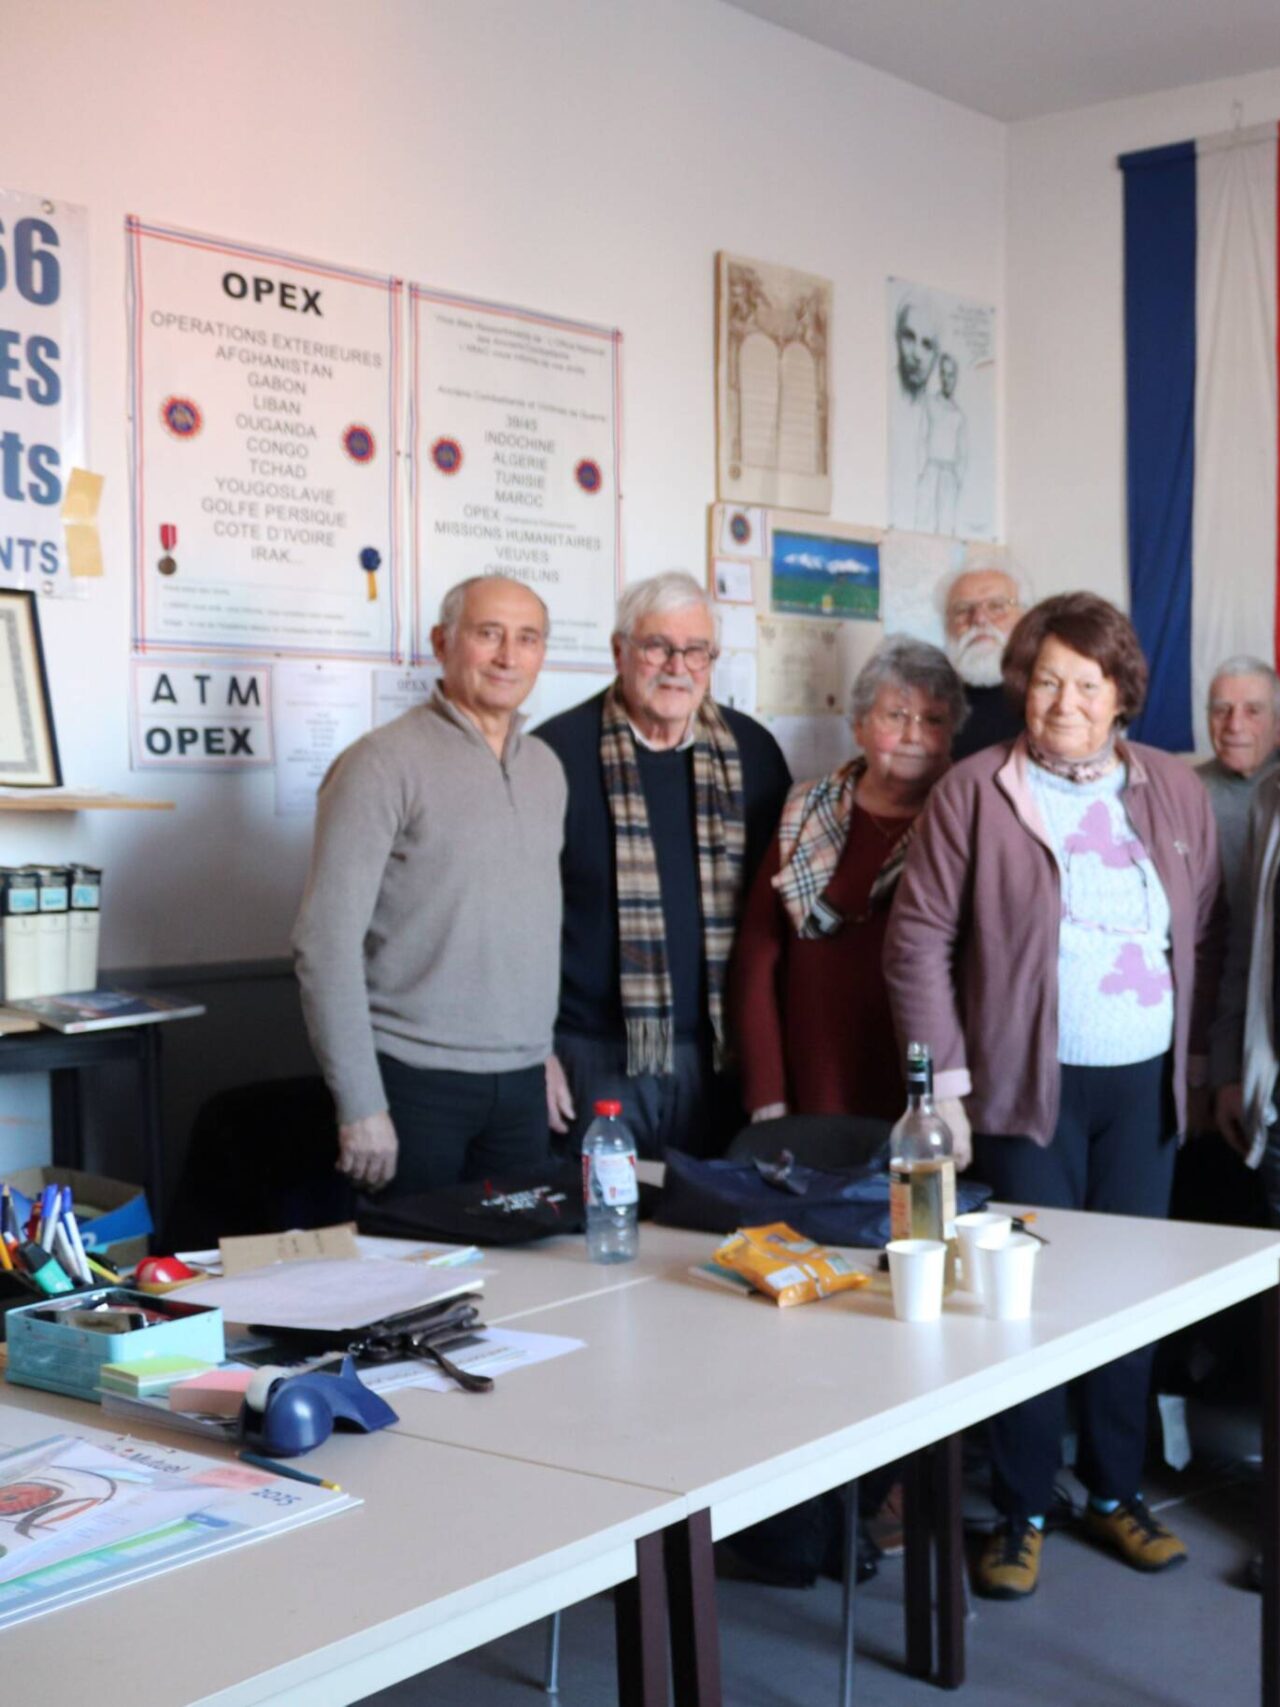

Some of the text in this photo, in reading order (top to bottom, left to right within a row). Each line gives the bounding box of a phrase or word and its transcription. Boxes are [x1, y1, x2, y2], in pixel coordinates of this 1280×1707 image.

[221, 271, 324, 317] OPEX
[150, 310, 382, 368] OPERATIONS EXTERIEURES
[215, 345, 333, 379] AFGHANISTAN
[247, 372, 306, 395] GABON
[253, 395, 302, 416] LIBAN
[235, 413, 317, 439] OUGANDA
[246, 436, 309, 459] CONGO
[484, 431, 556, 454] INDOCHINE
[250, 458, 307, 479] TCHAD
[493, 452, 548, 470] ALGERIE
[215, 477, 336, 505] YOUGOSLAVIE
[494, 490, 544, 508] MAROC
[201, 497, 347, 528] GOLFE PERSIQUE
[463, 503, 500, 522] OPEX
[267, 526, 336, 547] D'IVOIRE
[434, 520, 502, 540] MISSIONS
[505, 528, 602, 552] HUMANITAIRES
[495, 546, 549, 564] VEUVES
[145, 727, 255, 756] OPEX
